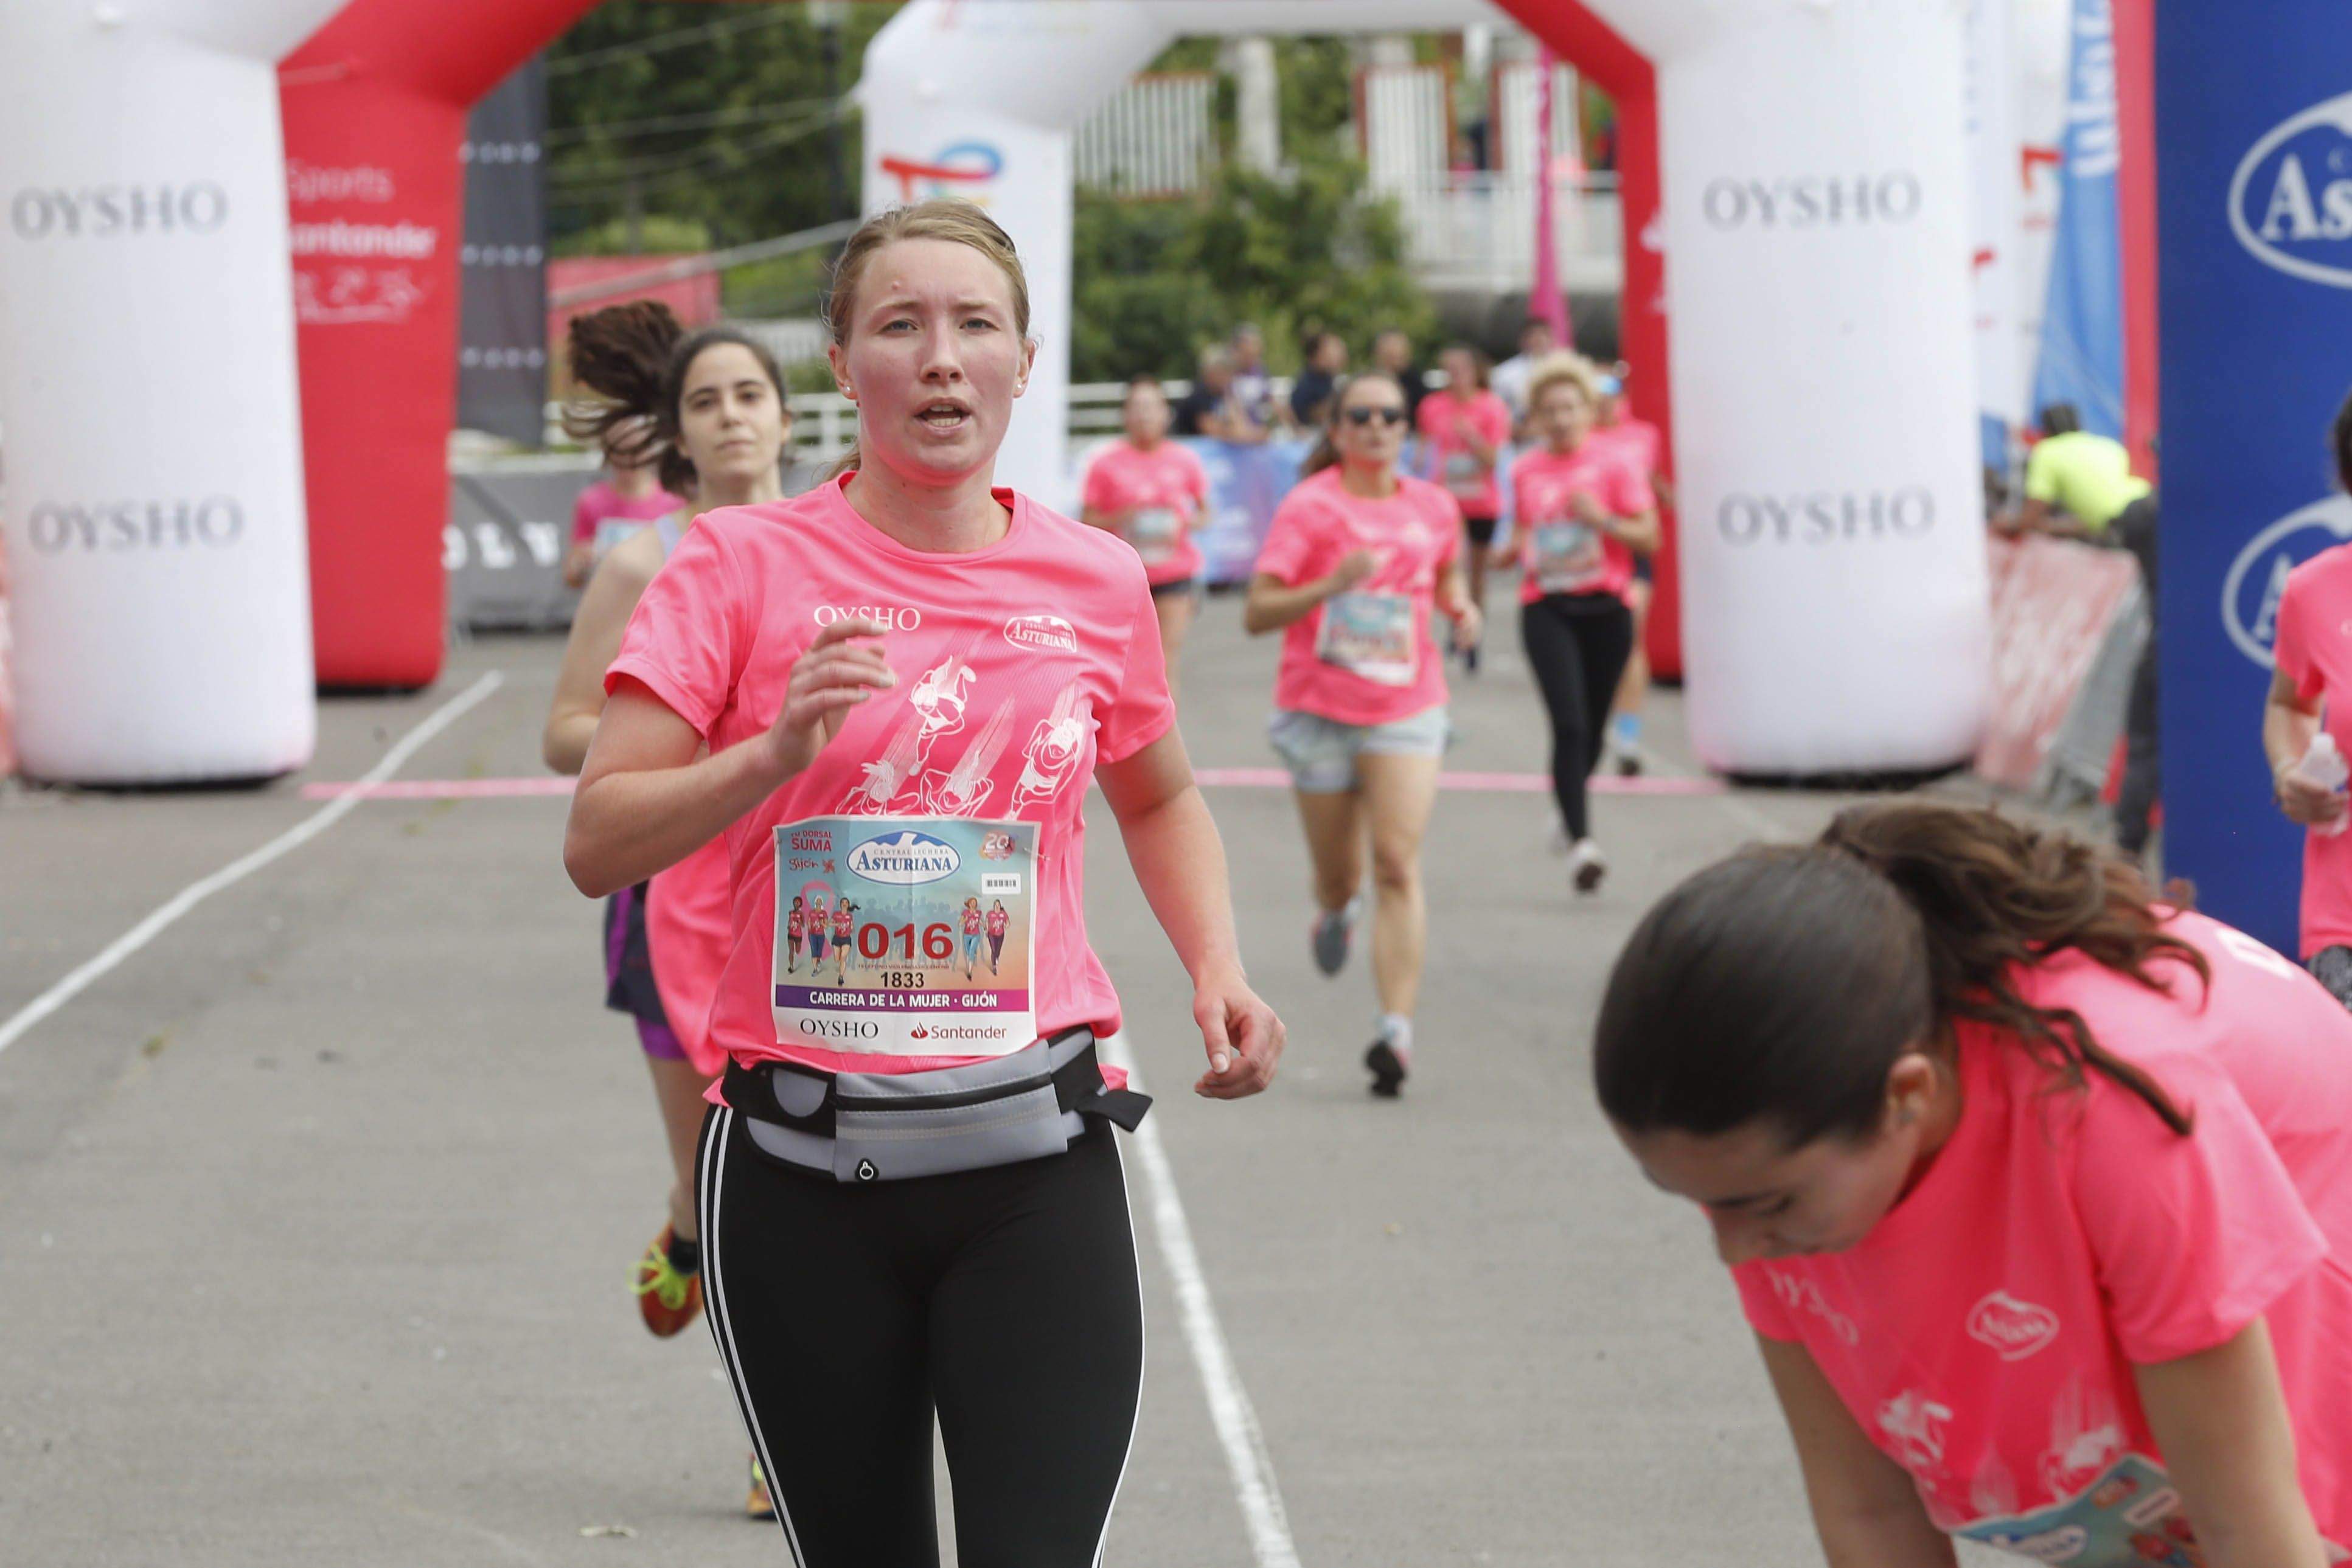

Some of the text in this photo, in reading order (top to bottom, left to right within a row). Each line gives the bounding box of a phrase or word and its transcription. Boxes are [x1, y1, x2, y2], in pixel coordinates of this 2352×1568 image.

[10, 180, 229, 240] OYSHO
[1702, 170, 1921, 231] OYSHO
[29, 494, 245, 555] OYSHO
[1717, 485, 1933, 546] OYSHO
[813, 605, 921, 631] OYSHO
[791, 837, 832, 852] SUMA
[855, 850, 953, 871] ASTURIANA
[858, 922, 953, 960] 016
[880, 971, 925, 988] 1833
[809, 991, 997, 1007] CARRERA DE LA MUJER GIJÓN
[800, 1018, 1006, 1039] OYSHO Santander
